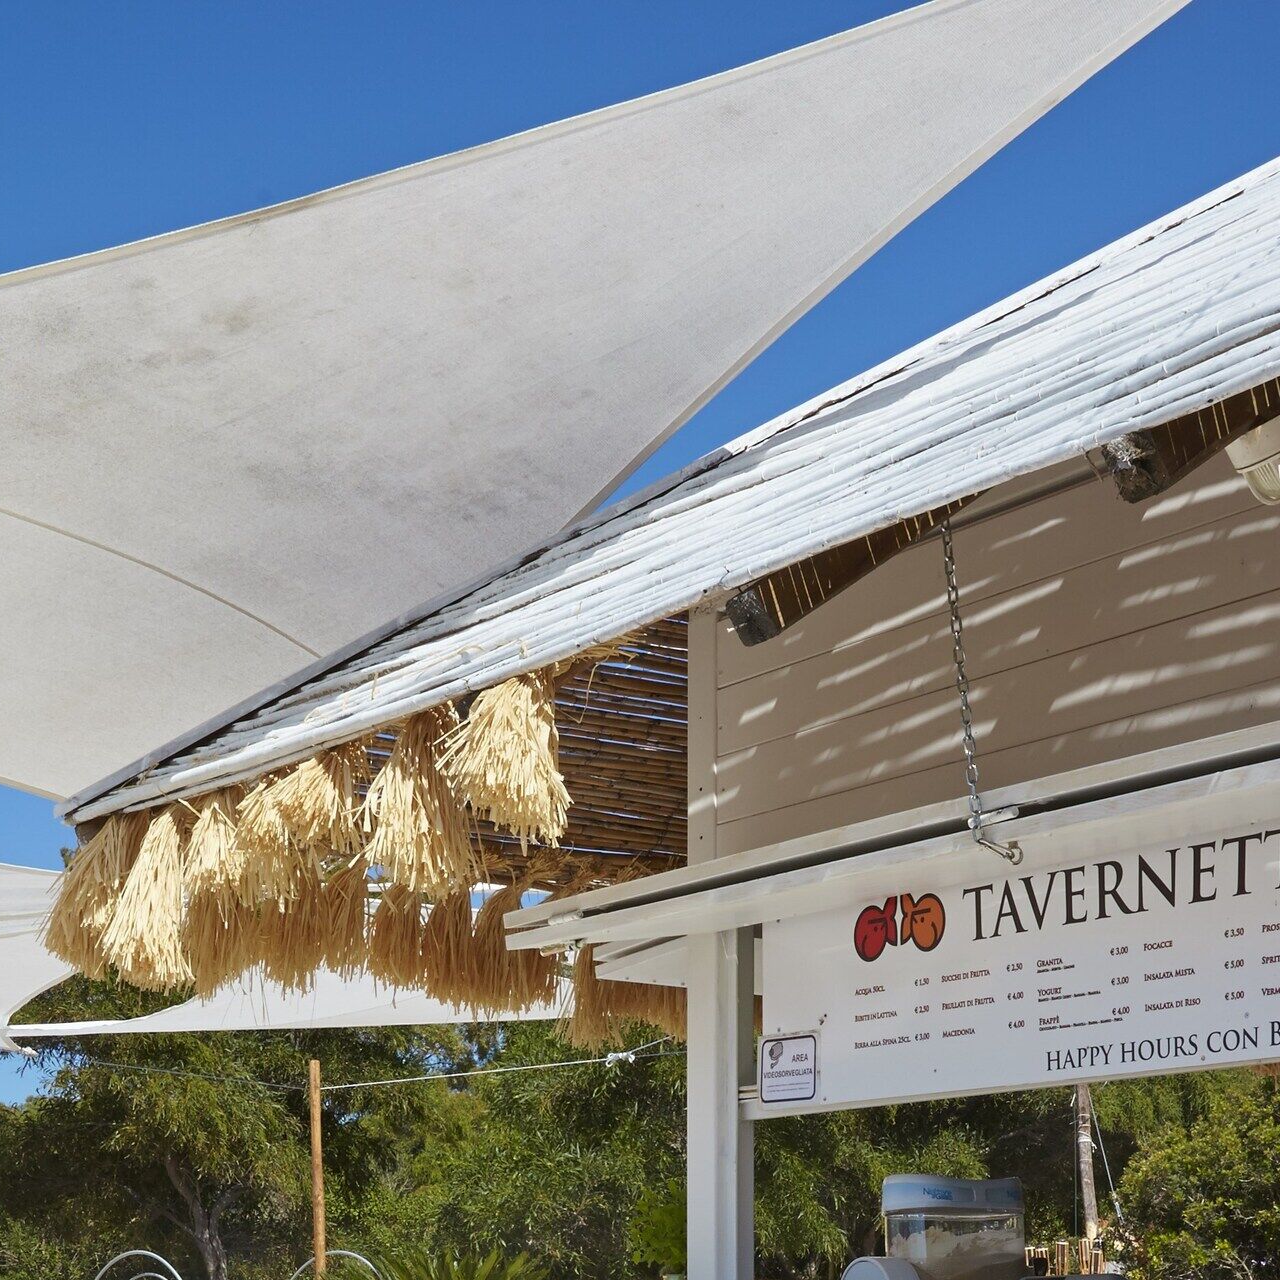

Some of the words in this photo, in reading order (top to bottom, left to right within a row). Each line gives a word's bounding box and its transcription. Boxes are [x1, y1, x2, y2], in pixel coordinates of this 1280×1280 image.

[1143, 940, 1173, 951] FOCACCE
[1230, 927, 1244, 937] 3,50
[1036, 958, 1063, 968] GRANITA
[941, 974, 961, 983] SUCCHI
[962, 972, 969, 980] DI
[970, 969, 991, 979] FRUTTA
[1144, 971, 1173, 982] INSALATA
[1174, 967, 1195, 977] MISTA
[1230, 959, 1244, 969] 5,00
[1037, 987, 1062, 997] YOGURT
[942, 1001, 966, 1011] FRULLATI
[974, 997, 995, 1006] FRUTTA
[1144, 1001, 1174, 1012] INSALATA
[1175, 1000, 1183, 1008] DI
[1185, 998, 1201, 1007] RISO
[1230, 991, 1245, 1000] 5,00
[877, 1011, 898, 1019] LATTINA
[942, 1027, 976, 1039] MACEDONIA
[882, 1038, 897, 1046] SPINA
[1046, 1043, 1113, 1071] HAPPY
[1120, 1034, 1199, 1064] HOURS
[1206, 1025, 1260, 1053] CON
[792, 1053, 809, 1062] AREA
[763, 1068, 813, 1079] VIDEOSORVEGLIATA
